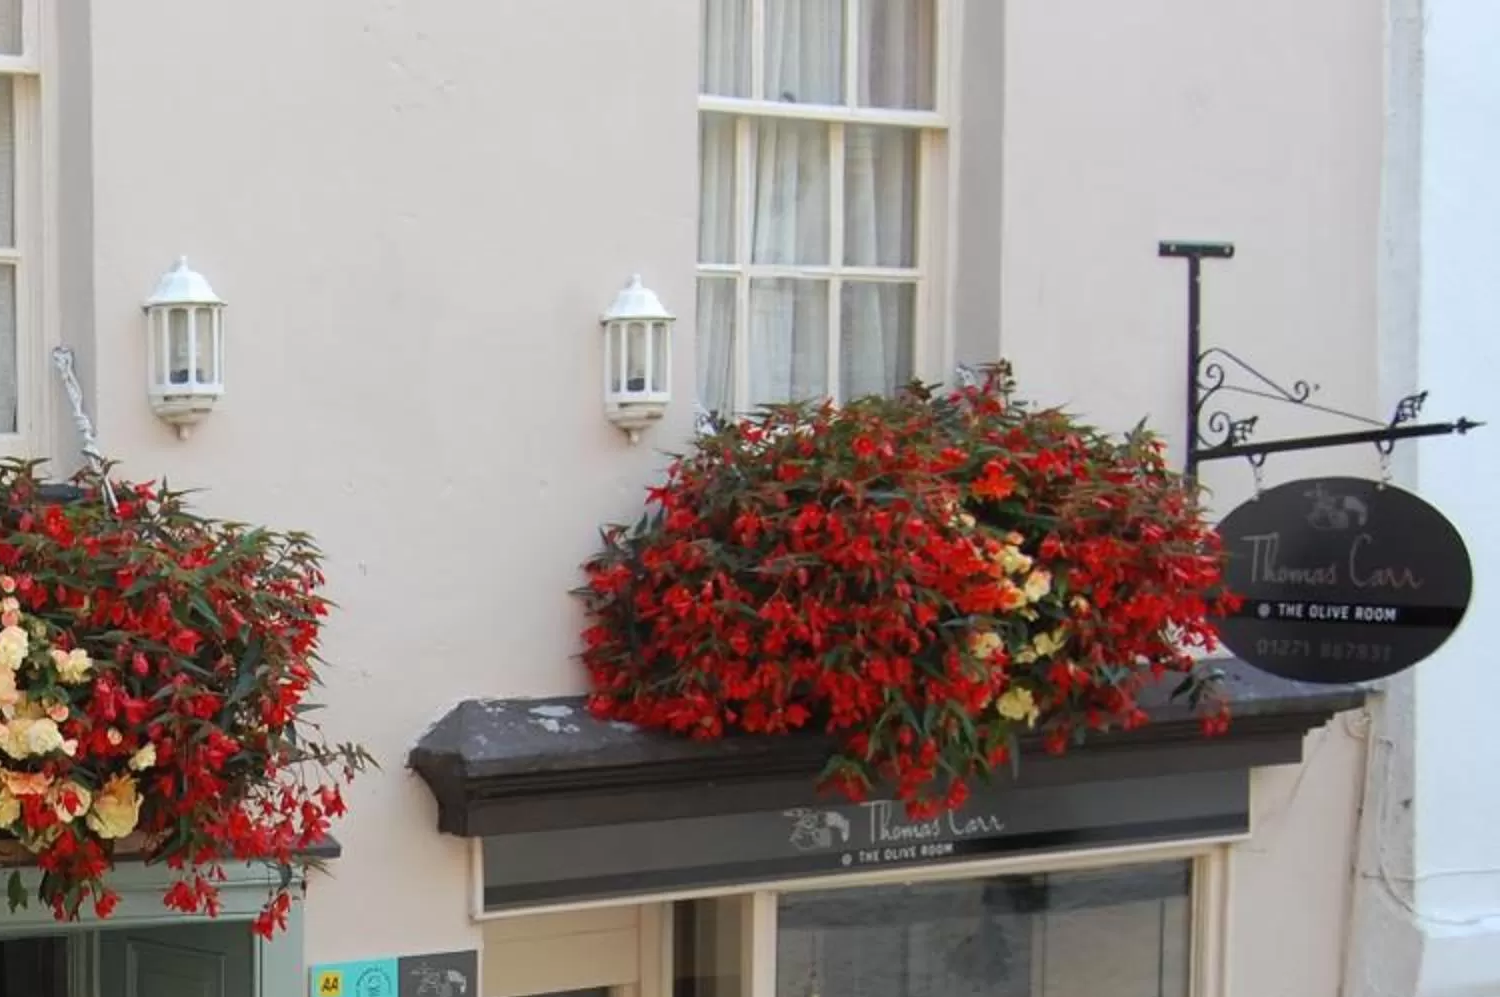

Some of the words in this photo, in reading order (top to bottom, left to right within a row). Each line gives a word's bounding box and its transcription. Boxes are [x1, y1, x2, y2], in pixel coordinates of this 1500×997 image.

[1240, 532, 1336, 584] Thomas
[1349, 533, 1424, 589] Carr
[1278, 603, 1303, 618] THE
[1308, 604, 1349, 620] OLIVE
[1354, 605, 1397, 622] ROOM
[859, 800, 941, 844] Thomas
[320, 975, 340, 993] AA
